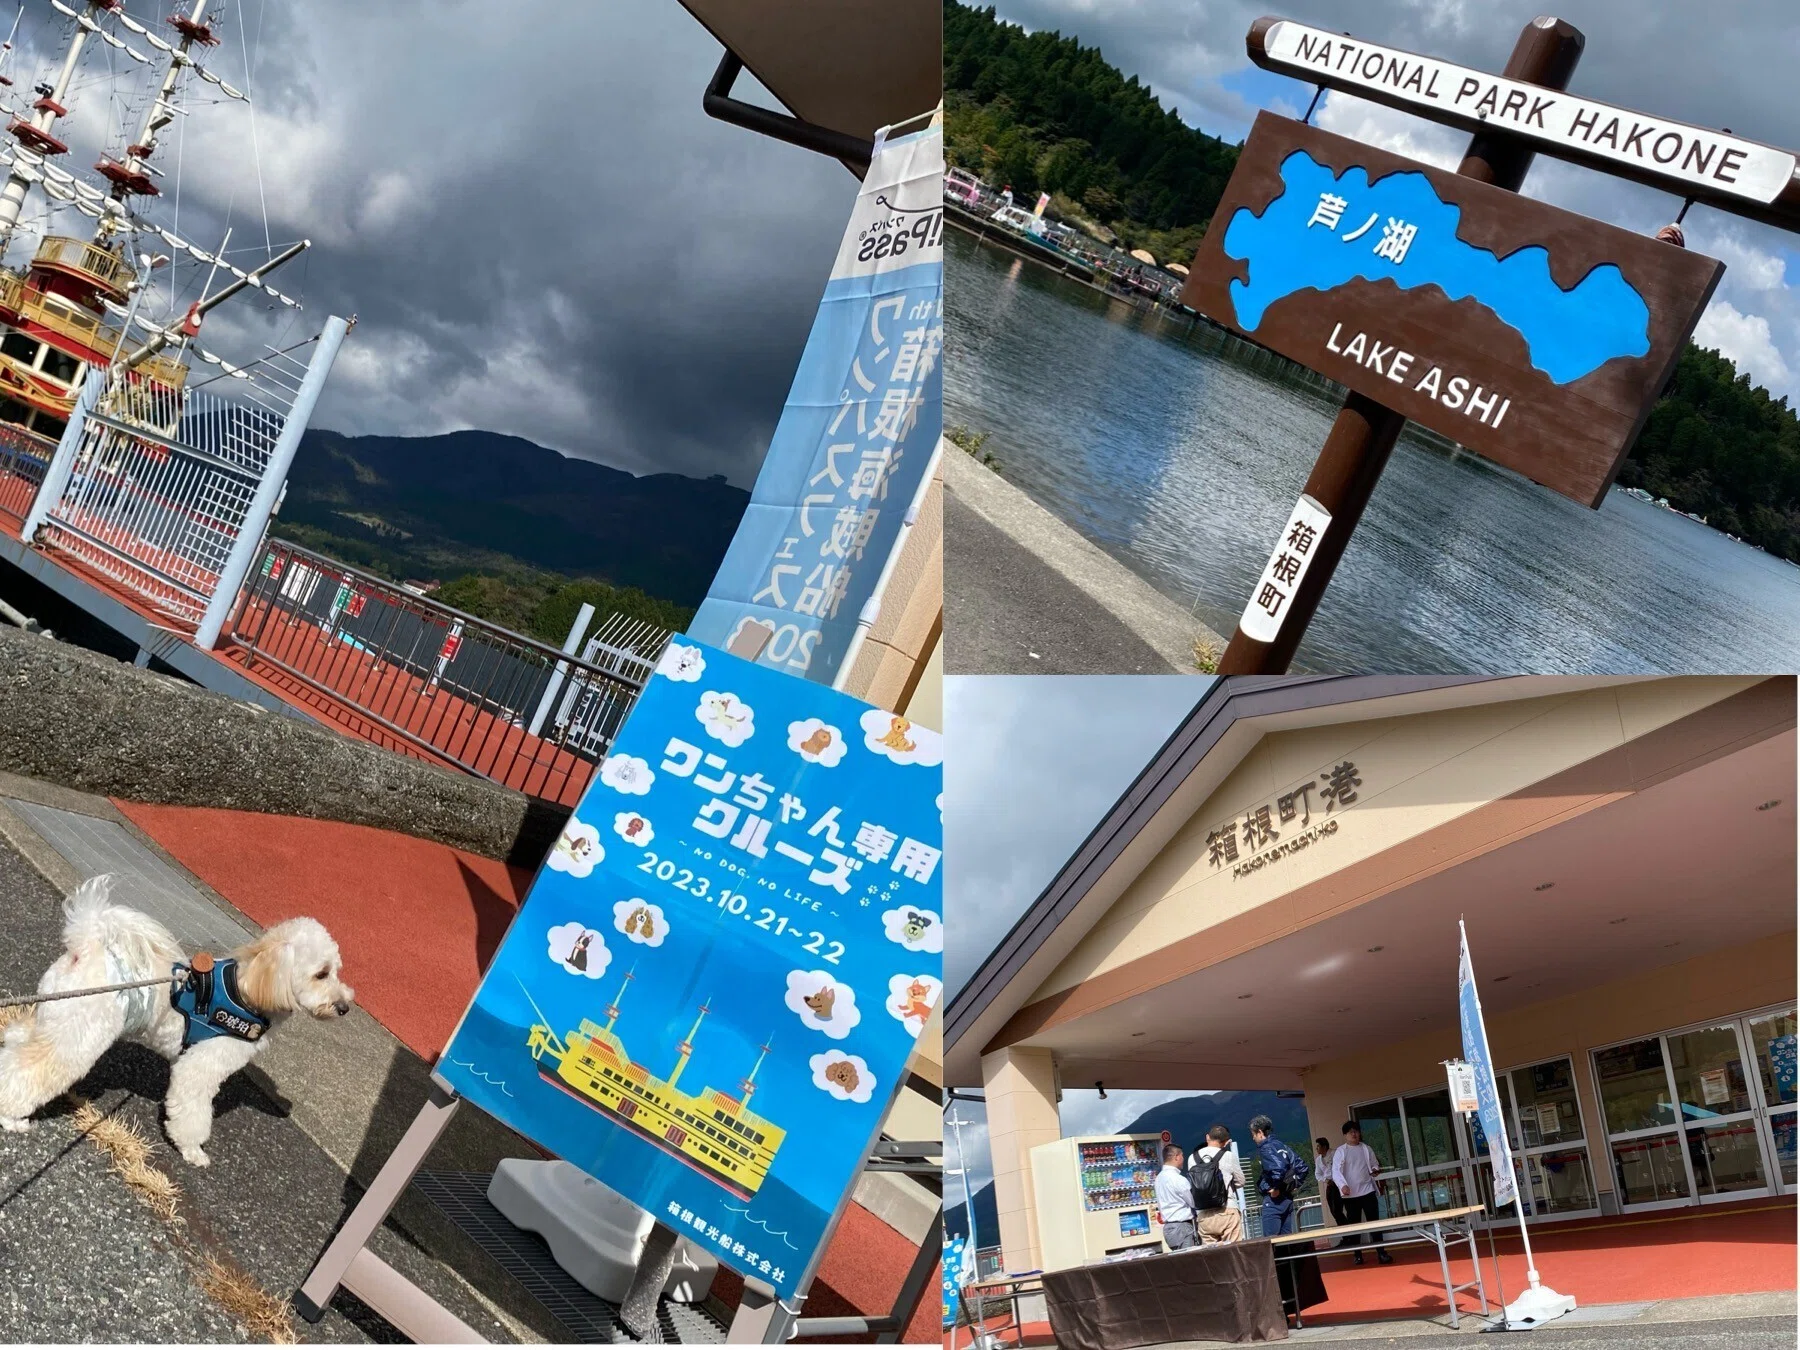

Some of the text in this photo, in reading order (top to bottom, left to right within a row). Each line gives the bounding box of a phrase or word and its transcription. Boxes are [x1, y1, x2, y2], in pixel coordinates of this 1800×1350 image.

[1295, 34, 1747, 184] NATIONAL PARK HAKONE
[1308, 193, 1419, 265] 芦ノ湖
[1326, 321, 1511, 429] LAKE ASHI
[1256, 519, 1318, 618] 箱根町
[660, 737, 943, 885] ワンちゃん専用
[691, 796, 864, 895] クルーズ
[1206, 761, 1362, 868] 箱根町港
[636, 851, 846, 965] 2023.10.21~22
[693, 847, 713, 860] NO
[719, 858, 750, 878] DOG,
[757, 877, 777, 890] NO
[783, 888, 823, 912] LIFE
[667, 1200, 786, 1284] 箱根観光船株式会社
